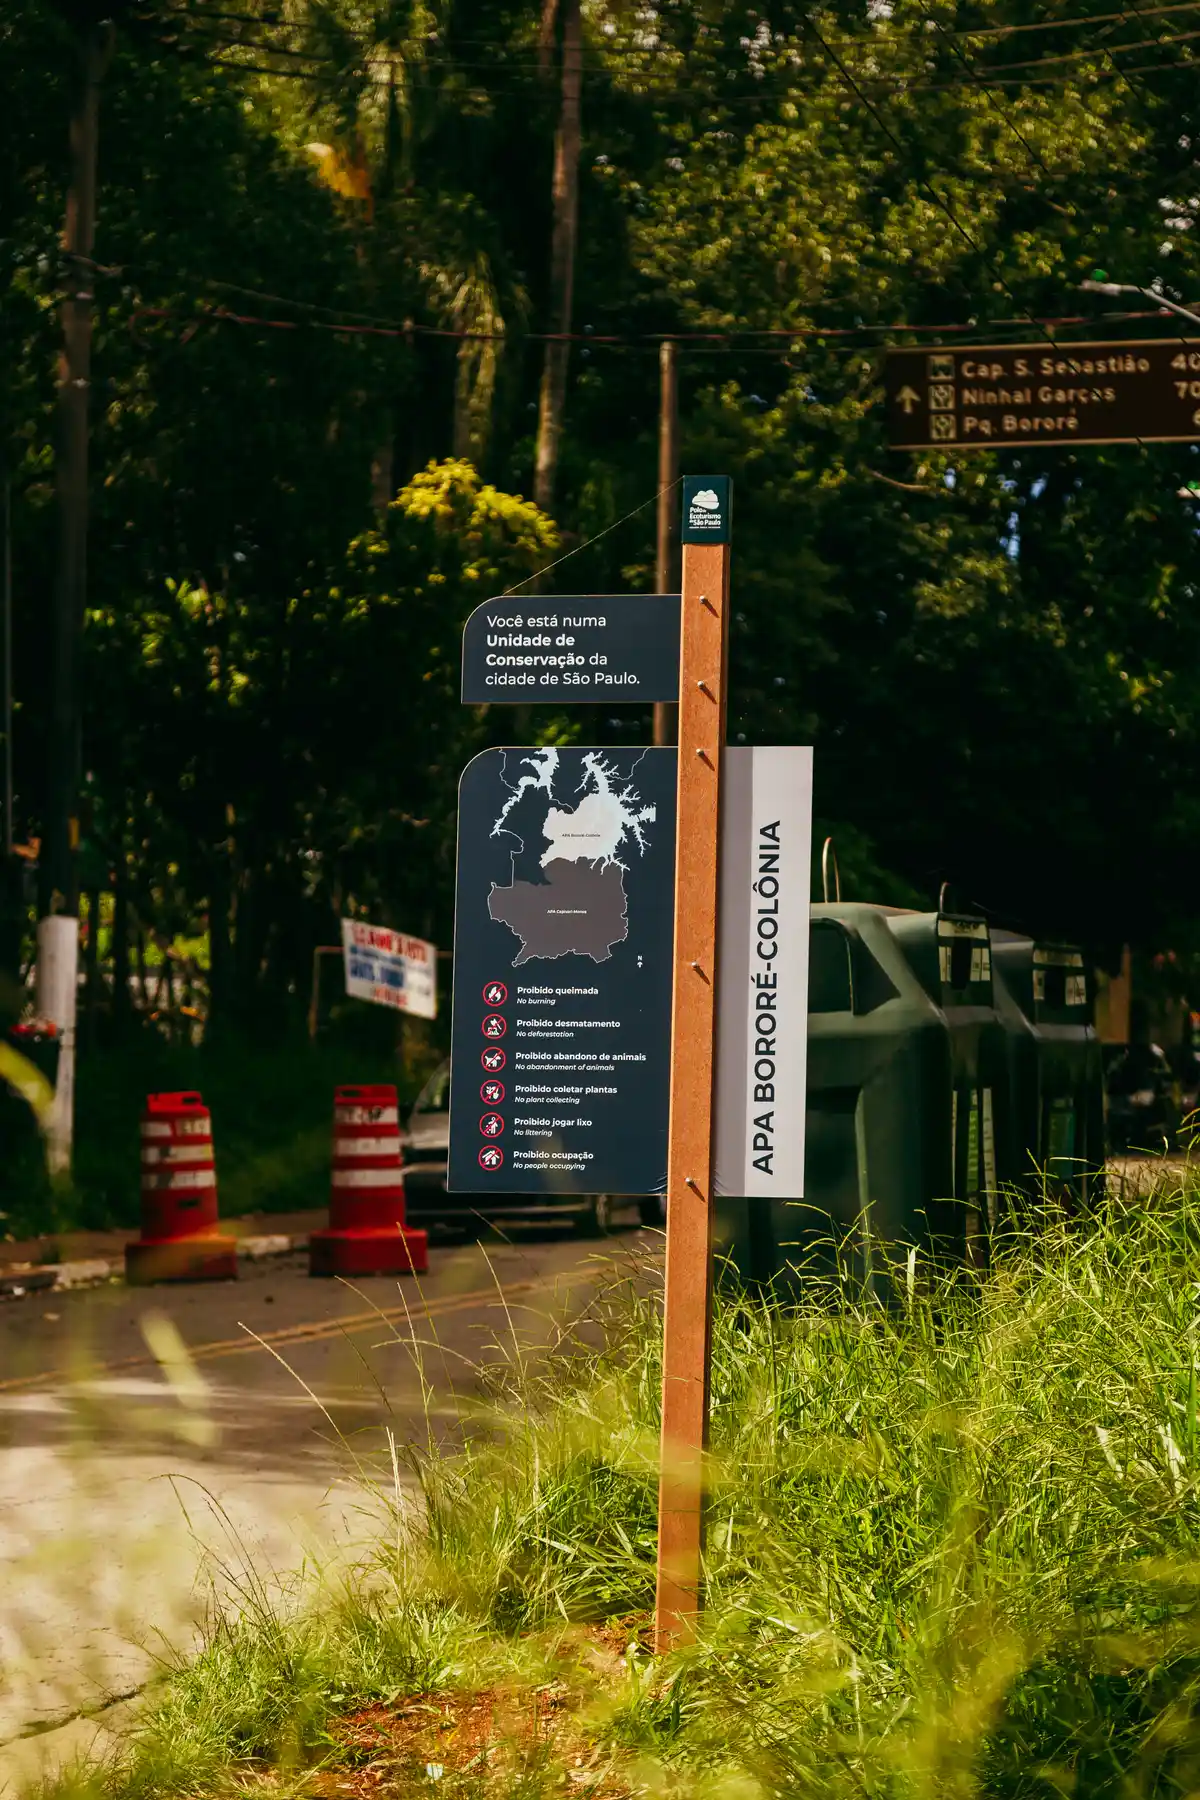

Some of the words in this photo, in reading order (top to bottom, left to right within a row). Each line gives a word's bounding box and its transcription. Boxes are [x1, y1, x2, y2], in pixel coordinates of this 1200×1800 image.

[962, 360, 1007, 382] Cap.
[1040, 354, 1150, 374] Sebastião
[962, 388, 1031, 405] Ninhal
[963, 416, 997, 436] Pq.
[1003, 407, 1078, 431] Bororé
[487, 615, 523, 627] Você
[527, 615, 557, 627] está
[563, 617, 606, 626] numa
[487, 634, 551, 646] Unidade
[556, 634, 575, 646] de
[486, 653, 585, 668] Conservação
[589, 653, 607, 665] da
[486, 673, 535, 685] cidade
[540, 673, 558, 685] de
[563, 672, 590, 684] São
[595, 672, 640, 684] Paulo.
[751, 820, 781, 1102] BORORÉ-COLÔNIA
[518, 986, 553, 995] Proibido
[555, 987, 598, 996] queimada
[528, 998, 556, 1006] burning
[517, 1019, 553, 1027] Proibido
[555, 1020, 620, 1028] desmatamento
[516, 1052, 551, 1060] Proibido
[554, 1053, 597, 1061] abandono
[599, 1053, 610, 1061] de
[612, 1053, 646, 1062] animais
[586, 1064, 614, 1072] animals
[516, 1085, 551, 1093] Proibido
[553, 1086, 583, 1094] coletar
[586, 1086, 617, 1095] plantas
[546, 1097, 580, 1105] collecting
[515, 1118, 550, 1126] Proibido
[552, 1118, 575, 1128] jogar
[577, 1119, 592, 1127] lixo
[525, 1130, 552, 1138] littering
[752, 1111, 775, 1175] APA
[514, 1151, 550, 1159] Proibido
[552, 1152, 593, 1162] ocupação
[524, 1162, 548, 1170] people
[549, 1163, 585, 1171] occupying
